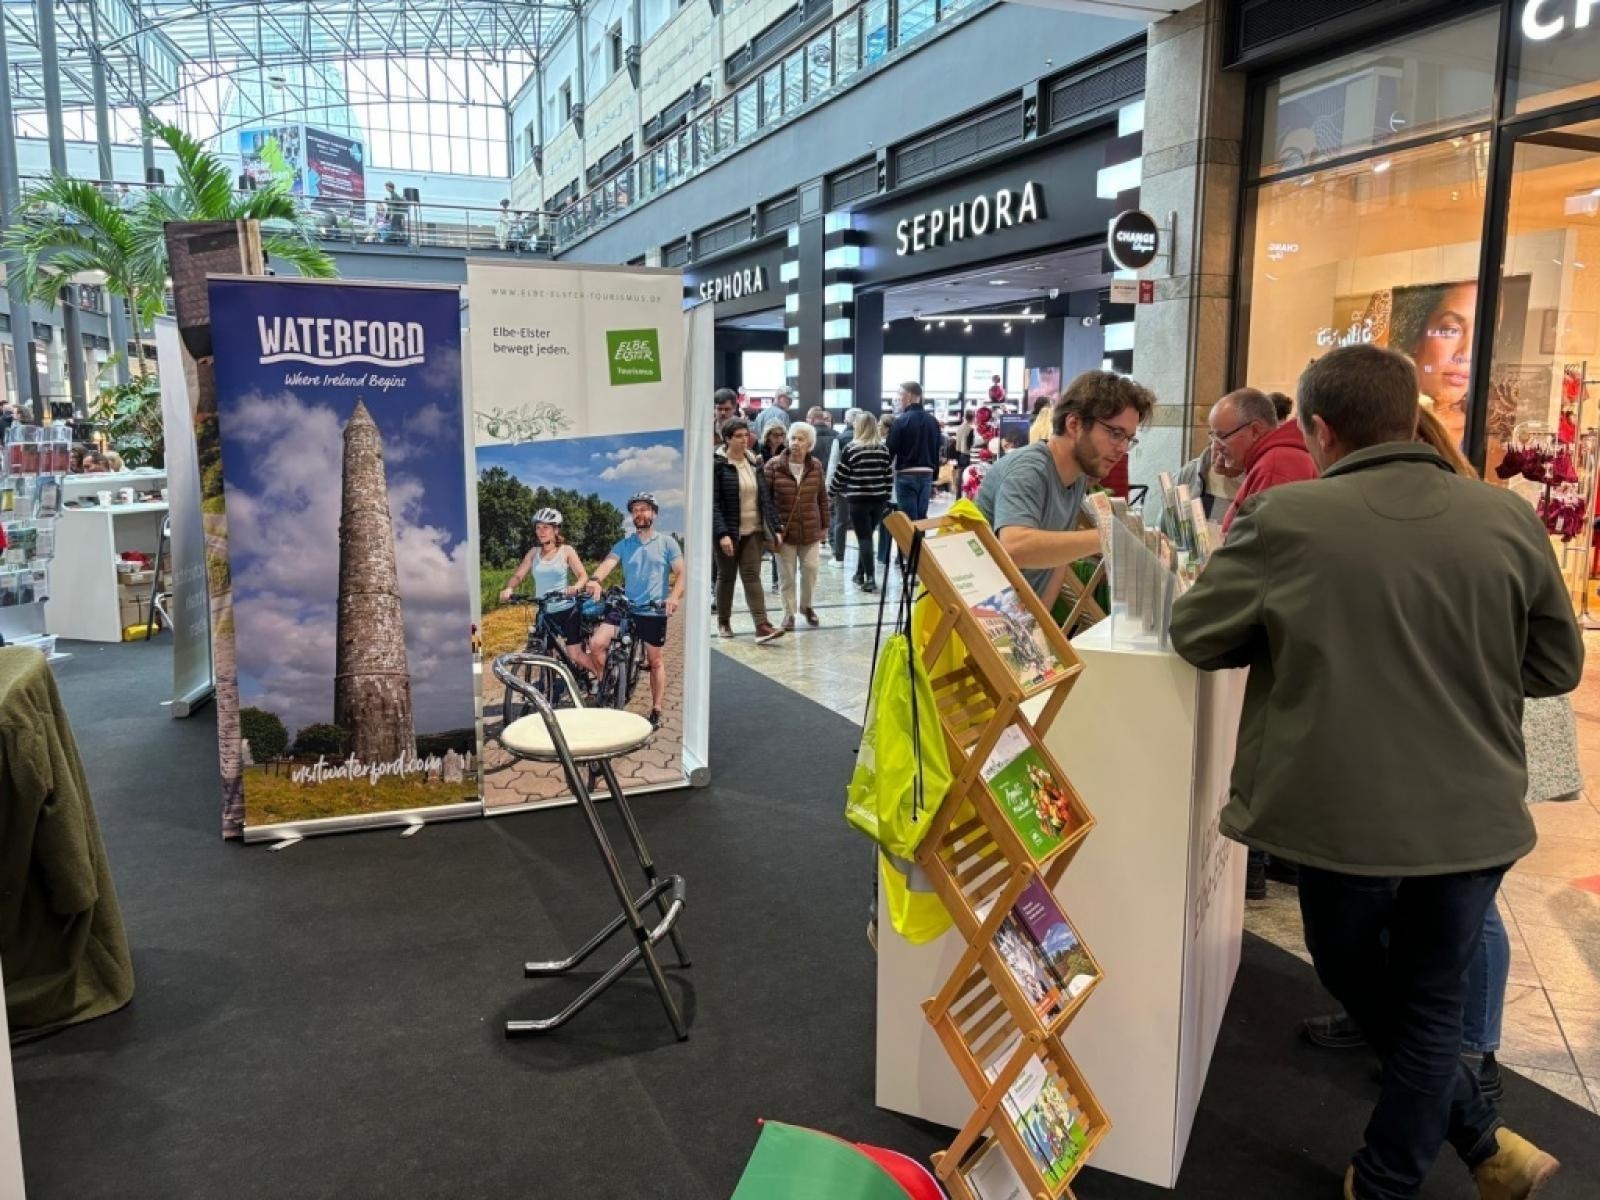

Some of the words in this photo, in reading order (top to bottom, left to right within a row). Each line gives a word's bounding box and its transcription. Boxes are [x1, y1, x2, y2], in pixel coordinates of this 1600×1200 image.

[896, 180, 1037, 256] SEPHORA
[1116, 230, 1155, 243] CHANGE
[699, 265, 763, 302] SEPHORA
[257, 315, 424, 358] WATERFORD
[493, 327, 551, 339] Elbe-Elster
[493, 342, 534, 356] bewegt
[536, 343, 570, 357] jeden.
[284, 370, 321, 387] Where
[323, 372, 368, 387] Ireland
[369, 374, 407, 392] Begins
[291, 749, 443, 786] visitwaterford.com
